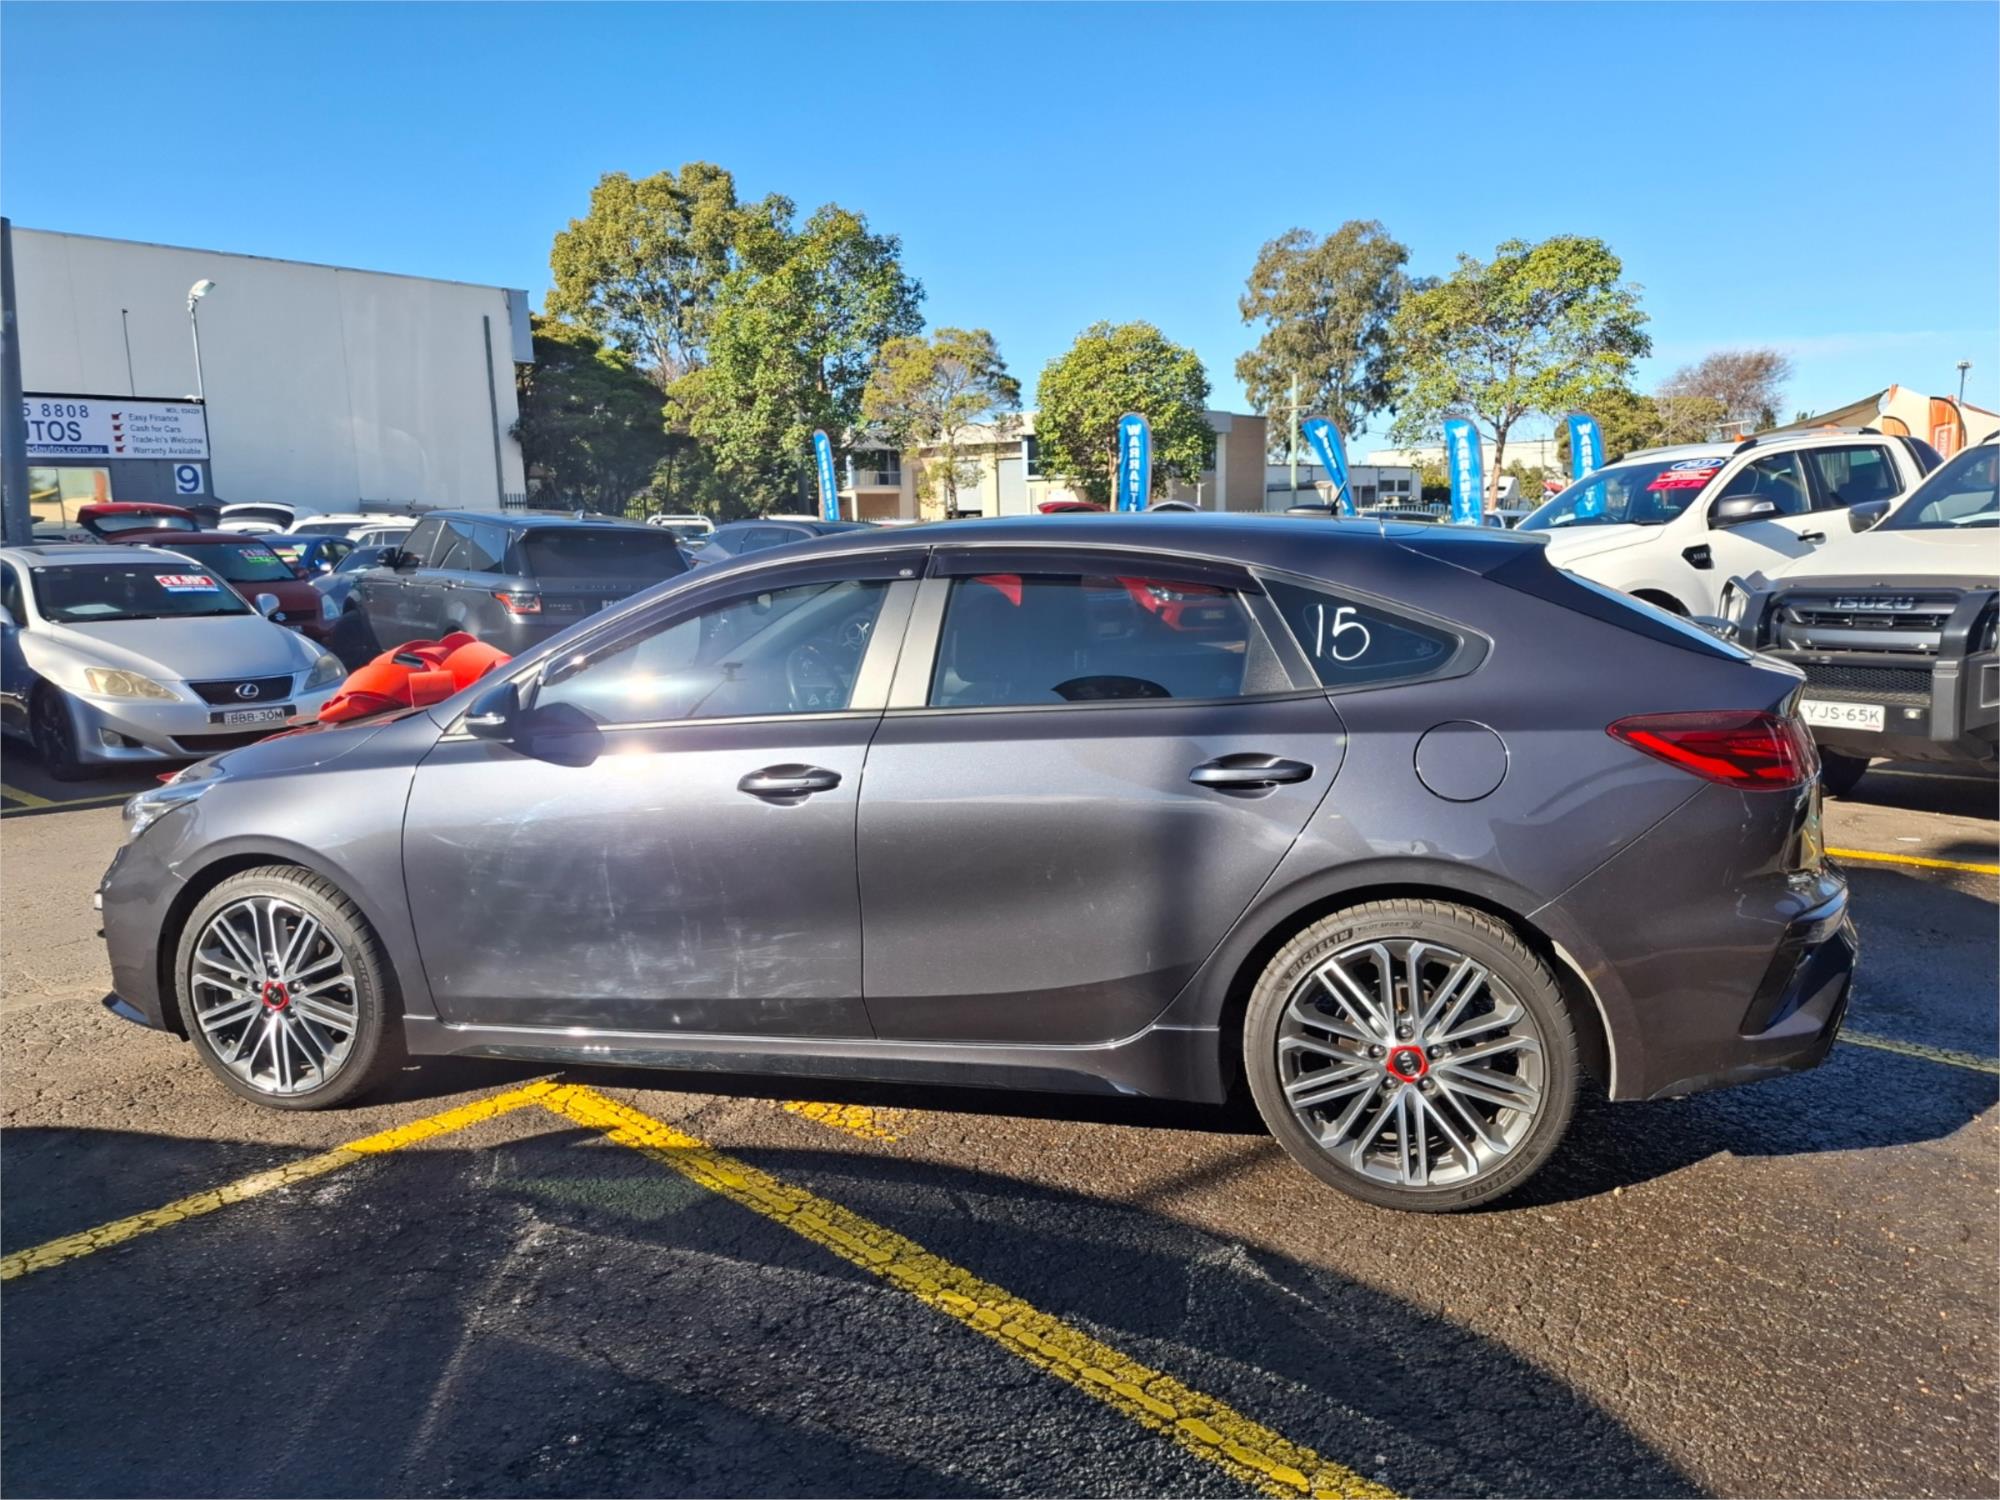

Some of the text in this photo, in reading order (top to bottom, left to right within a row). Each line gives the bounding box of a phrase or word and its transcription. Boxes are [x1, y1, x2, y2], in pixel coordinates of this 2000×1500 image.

[41, 403, 89, 418] 8808
[128, 413, 179, 423] Easy Finance
[130, 424, 182, 433] Cash for Cars
[169, 436, 204, 444] Welcome
[133, 447, 202, 456] Warranty Available
[1126, 424, 1142, 512] WARRANTY
[1453, 425, 1471, 513] WARRANTY
[176, 464, 200, 492] 9
[1834, 597, 1914, 610] ISUZU
[1316, 603, 1370, 661] 15
[1289, 928, 1353, 979] MICHELIN
